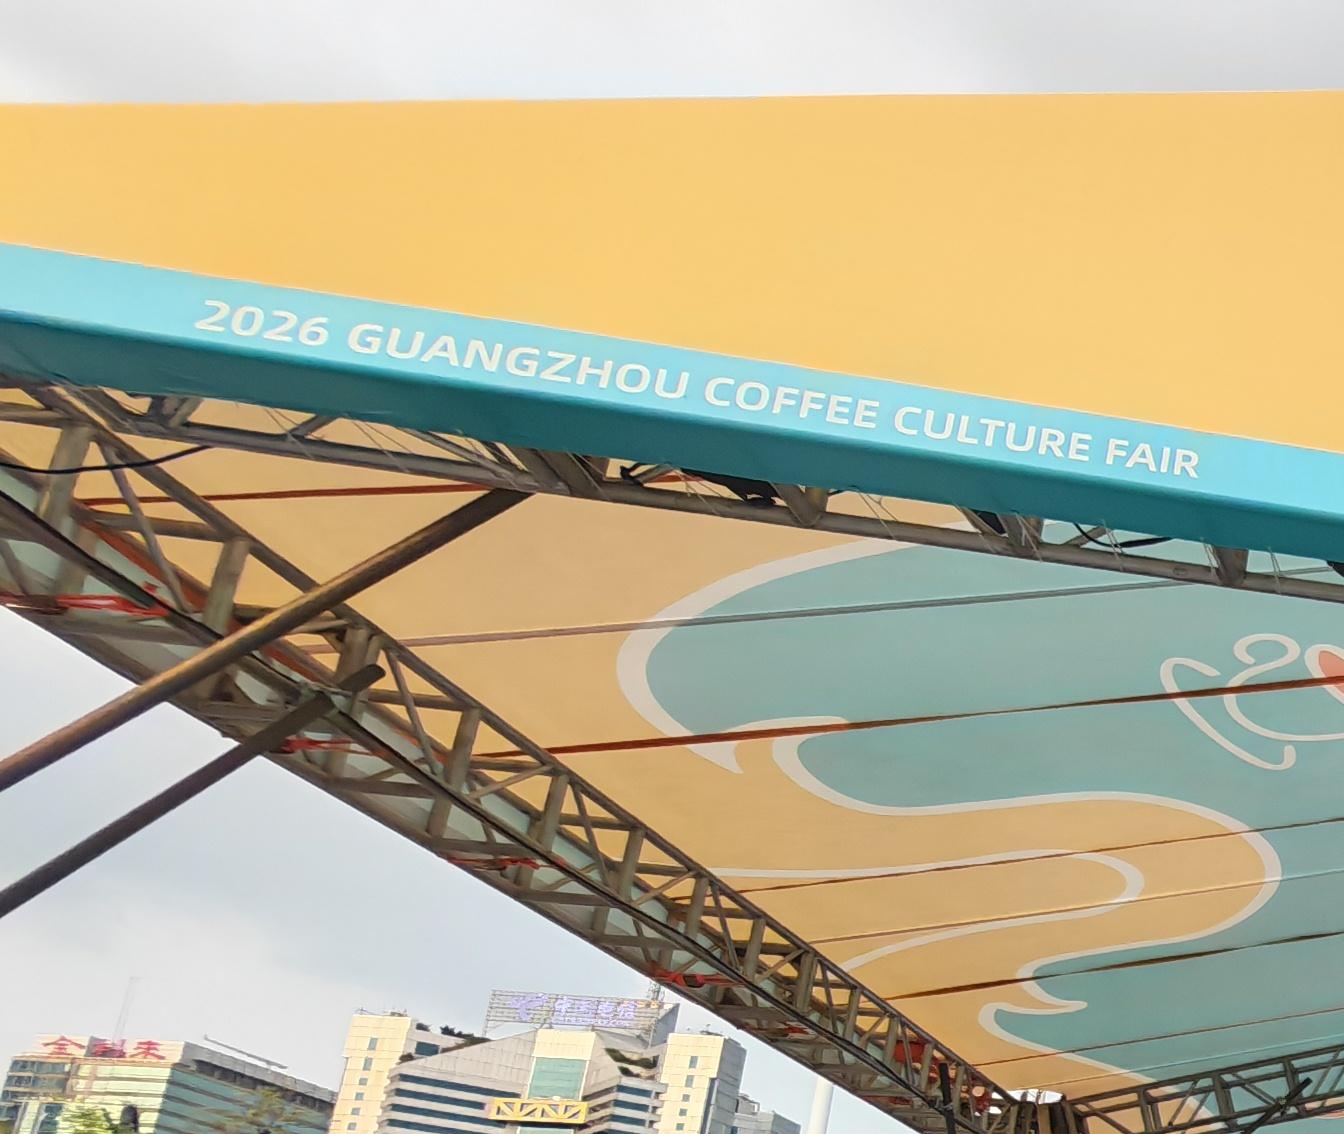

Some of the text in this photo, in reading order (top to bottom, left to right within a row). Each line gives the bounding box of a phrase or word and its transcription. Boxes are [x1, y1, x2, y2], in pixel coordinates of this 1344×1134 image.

[194, 299, 1200, 480] 2026 GUANGZHOU COFFEE CULTURE FAIR
